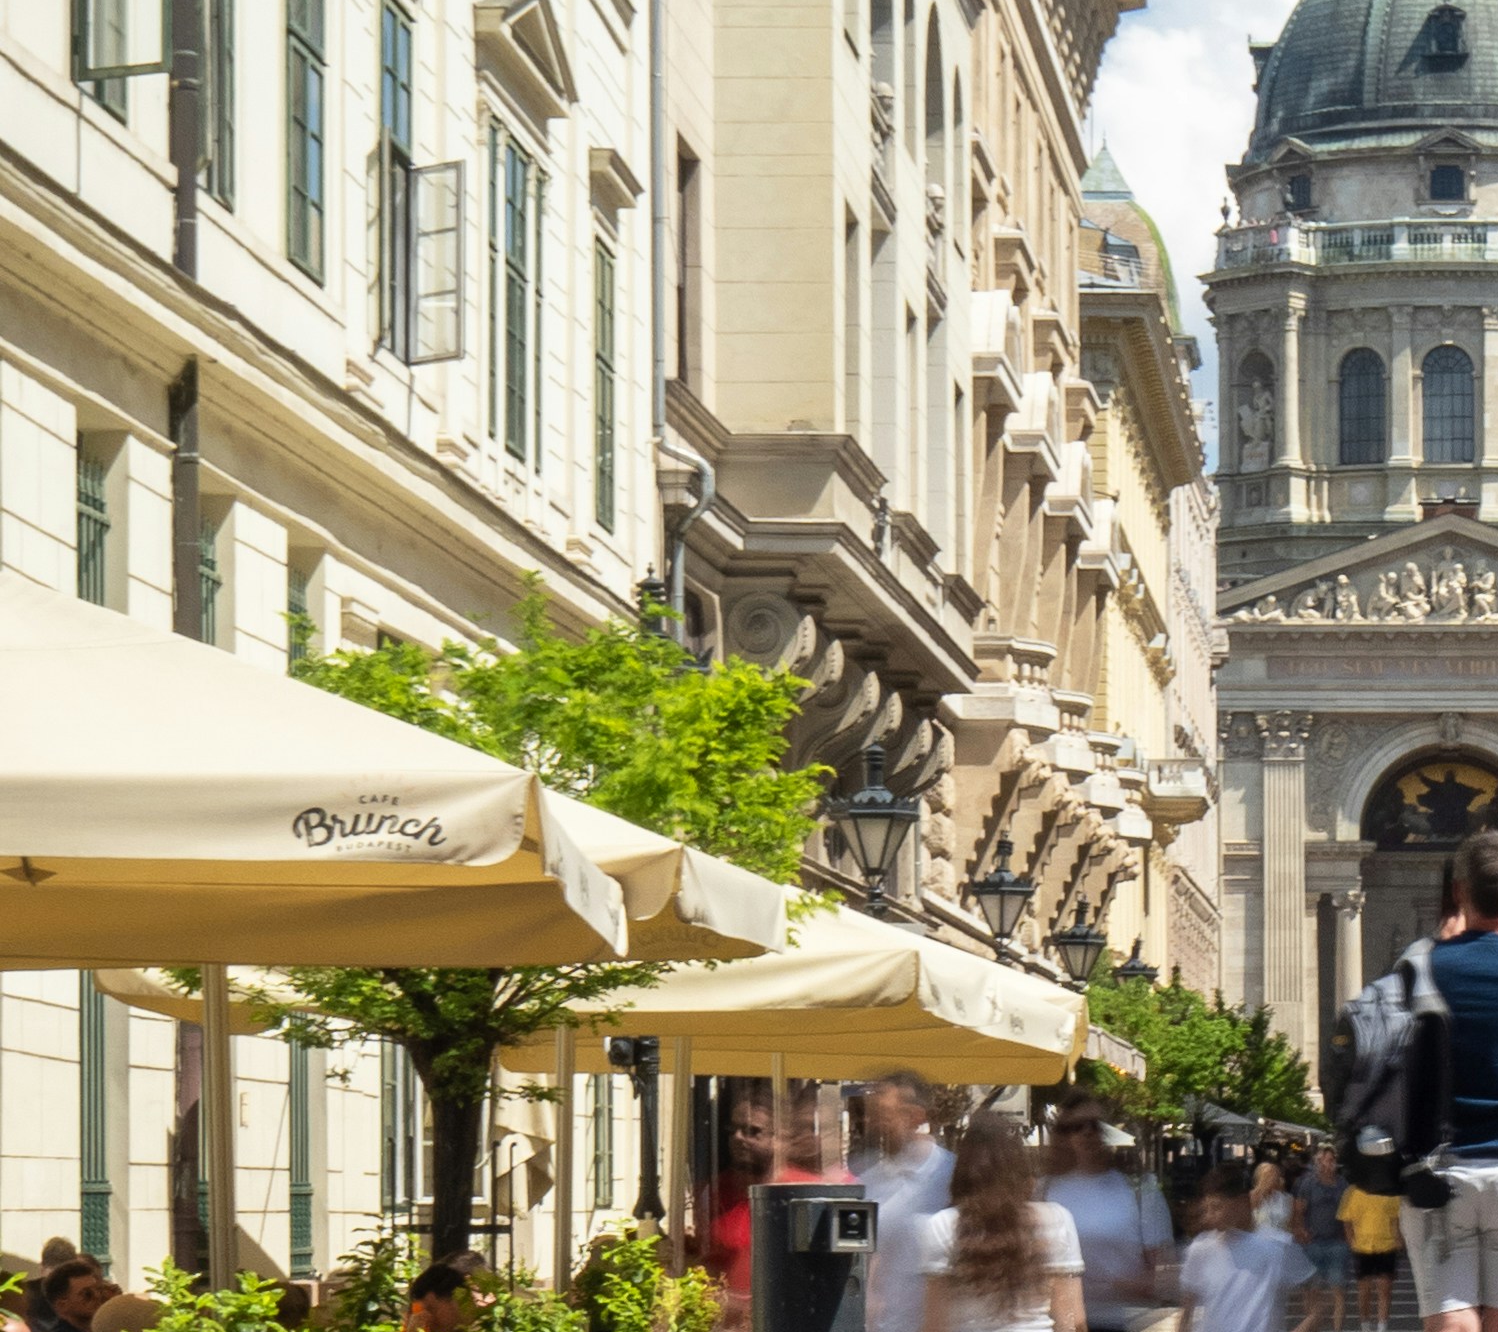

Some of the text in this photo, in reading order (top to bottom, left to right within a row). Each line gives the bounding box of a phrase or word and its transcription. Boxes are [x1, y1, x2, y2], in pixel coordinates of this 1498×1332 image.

[358, 794, 400, 806] CAFE
[292, 806, 448, 848] Brunch
[336, 840, 413, 854] BUDAPEST
